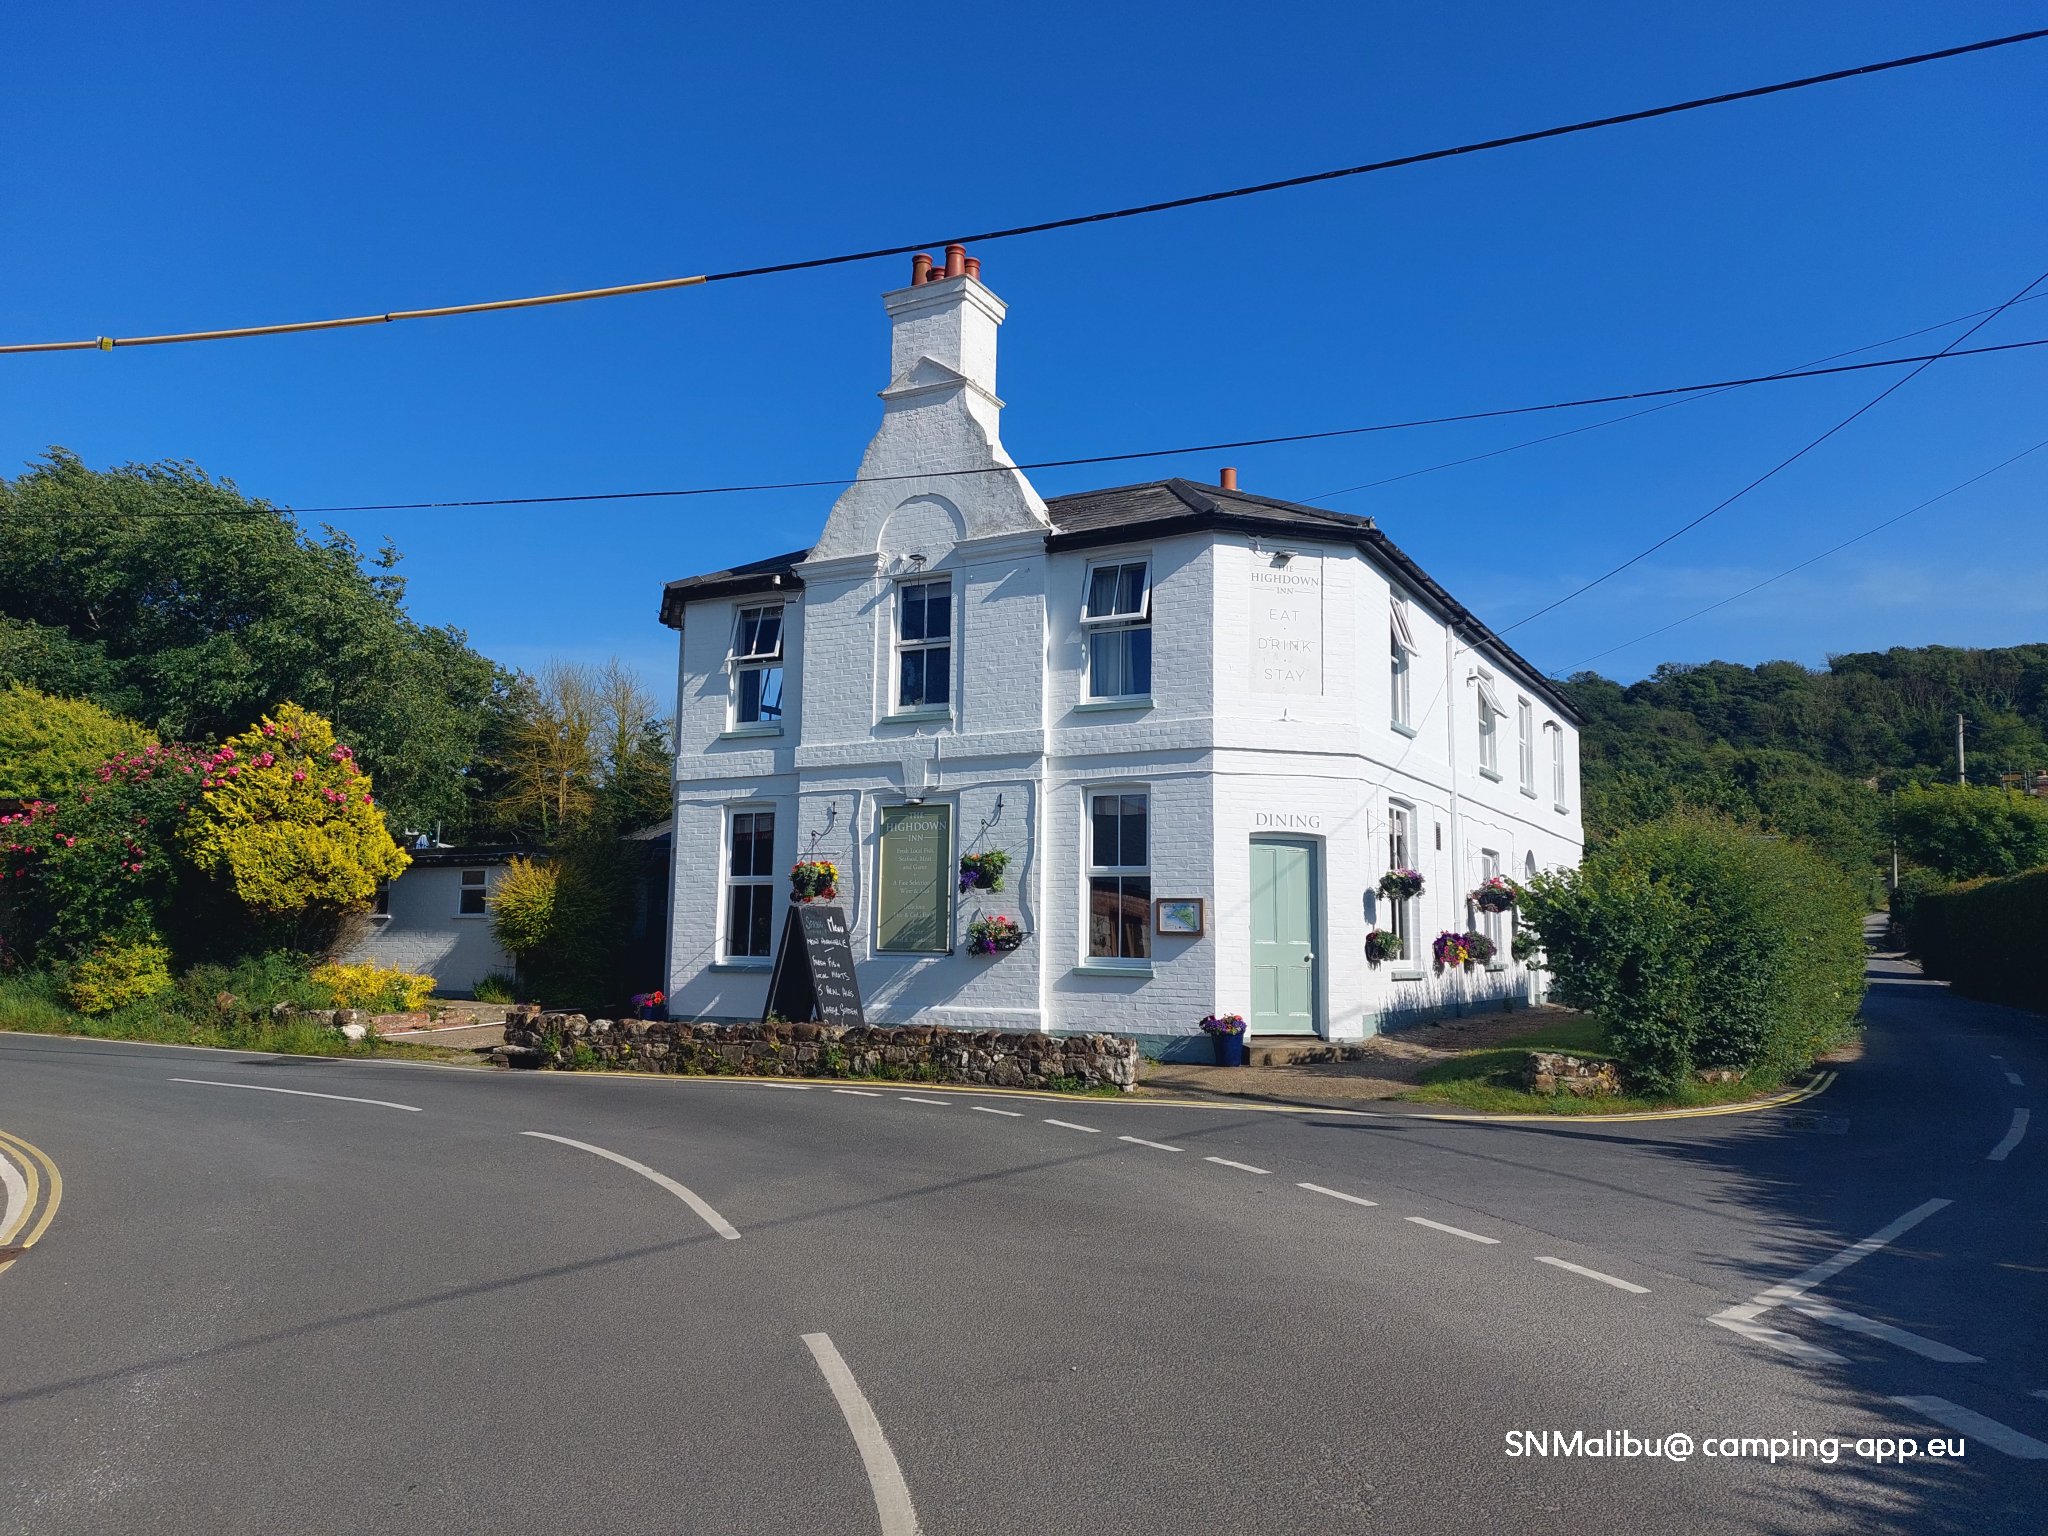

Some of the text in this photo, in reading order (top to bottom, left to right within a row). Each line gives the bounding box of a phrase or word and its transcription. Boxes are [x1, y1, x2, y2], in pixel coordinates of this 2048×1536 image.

[1278, 564, 1295, 573] THE
[1251, 572, 1320, 586] HIGHDOWN
[1276, 586, 1295, 595] INN
[1269, 608, 1301, 621] EAT
[1258, 637, 1312, 653] DRINK
[1264, 668, 1305, 682] STAY
[908, 811, 925, 819] THE
[1255, 812, 1320, 829] DINING
[886, 821, 947, 832] HIGHDOWN
[908, 834, 924, 842] INN
